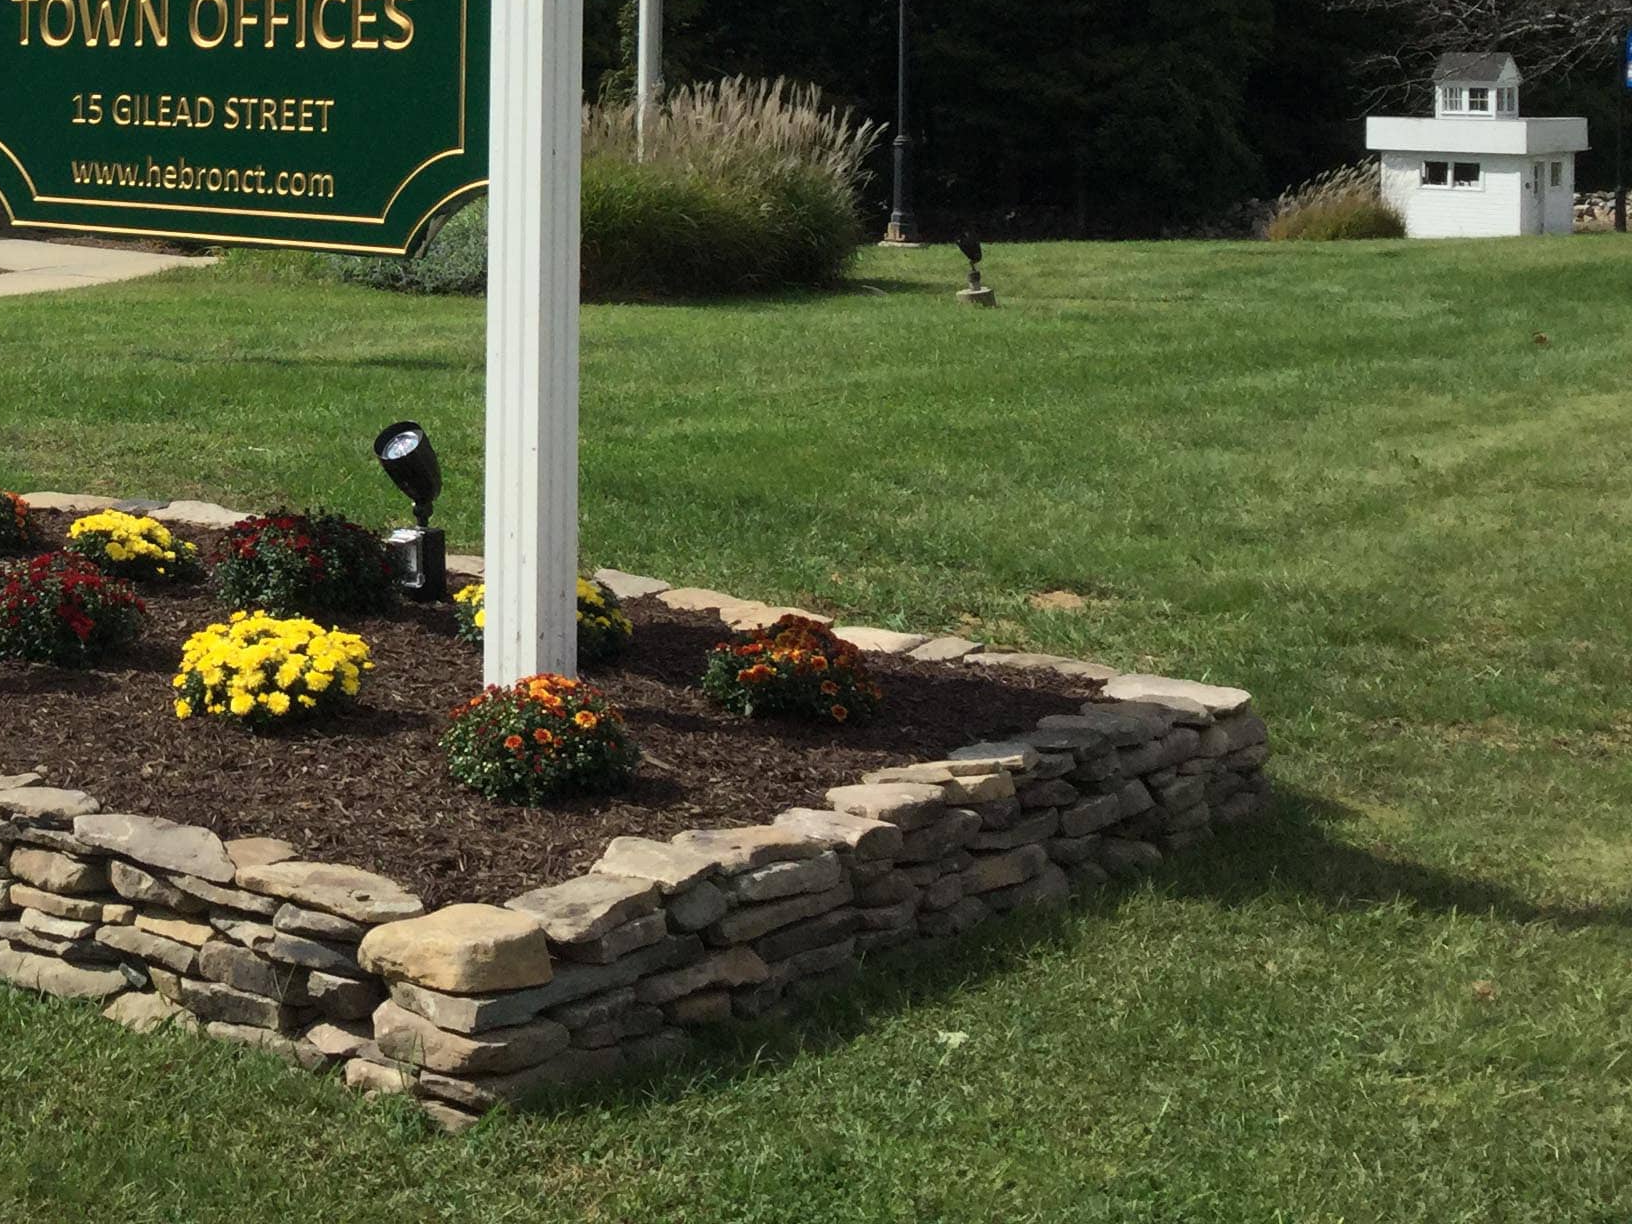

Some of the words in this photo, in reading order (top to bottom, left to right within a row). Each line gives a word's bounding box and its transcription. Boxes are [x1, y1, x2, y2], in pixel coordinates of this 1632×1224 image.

[71, 93, 103, 125] 15
[111, 94, 215, 129] GILEAD
[223, 97, 335, 133] STREET
[70, 156, 335, 199] www.hebronct.com
